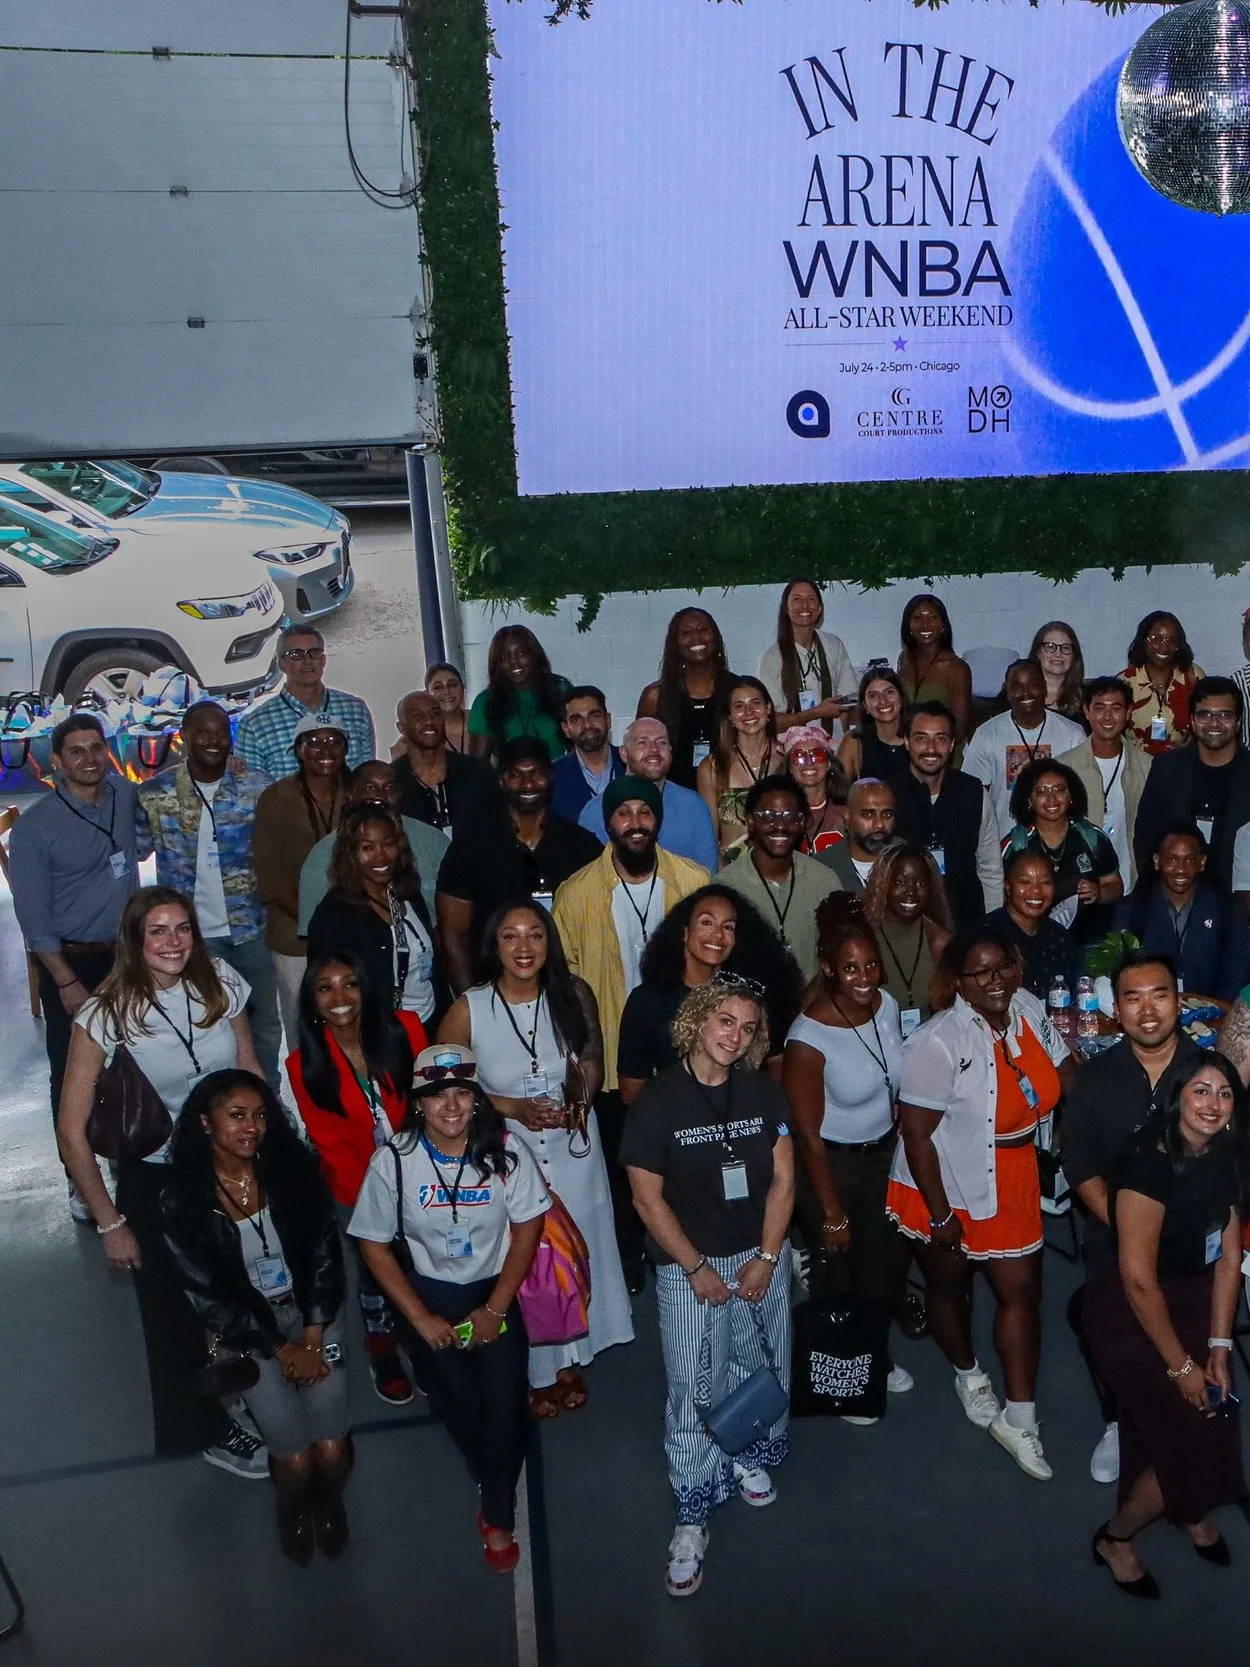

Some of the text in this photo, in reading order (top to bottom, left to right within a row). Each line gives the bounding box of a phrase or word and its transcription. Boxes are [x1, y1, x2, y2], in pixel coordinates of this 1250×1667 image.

[779, 41, 1015, 146] IN THE
[796, 154, 999, 228] ARENA
[782, 240, 1012, 298] WNBA
[784, 304, 1013, 329] ALL-STAR WEEKEND
[839, 361, 960, 375] July 24 2-5pm Chicago
[857, 409, 943, 428] CENTRE
[968, 409, 1010, 433] DH
[858, 428, 943, 437] COURT PRODUCTIONS
[674, 1124, 716, 1140] WOMEN'S
[716, 1119, 749, 1132] SORTS
[680, 1133, 713, 1146] FRONT
[739, 1125, 762, 1137] NEWS
[437, 1189, 490, 1203] WNBA
[809, 1351, 873, 1370] EVERYONE
[811, 1361, 870, 1379] WATCHES
[810, 1371, 870, 1388] WOMEN'S
[813, 1383, 865, 1397] SPORTS.
